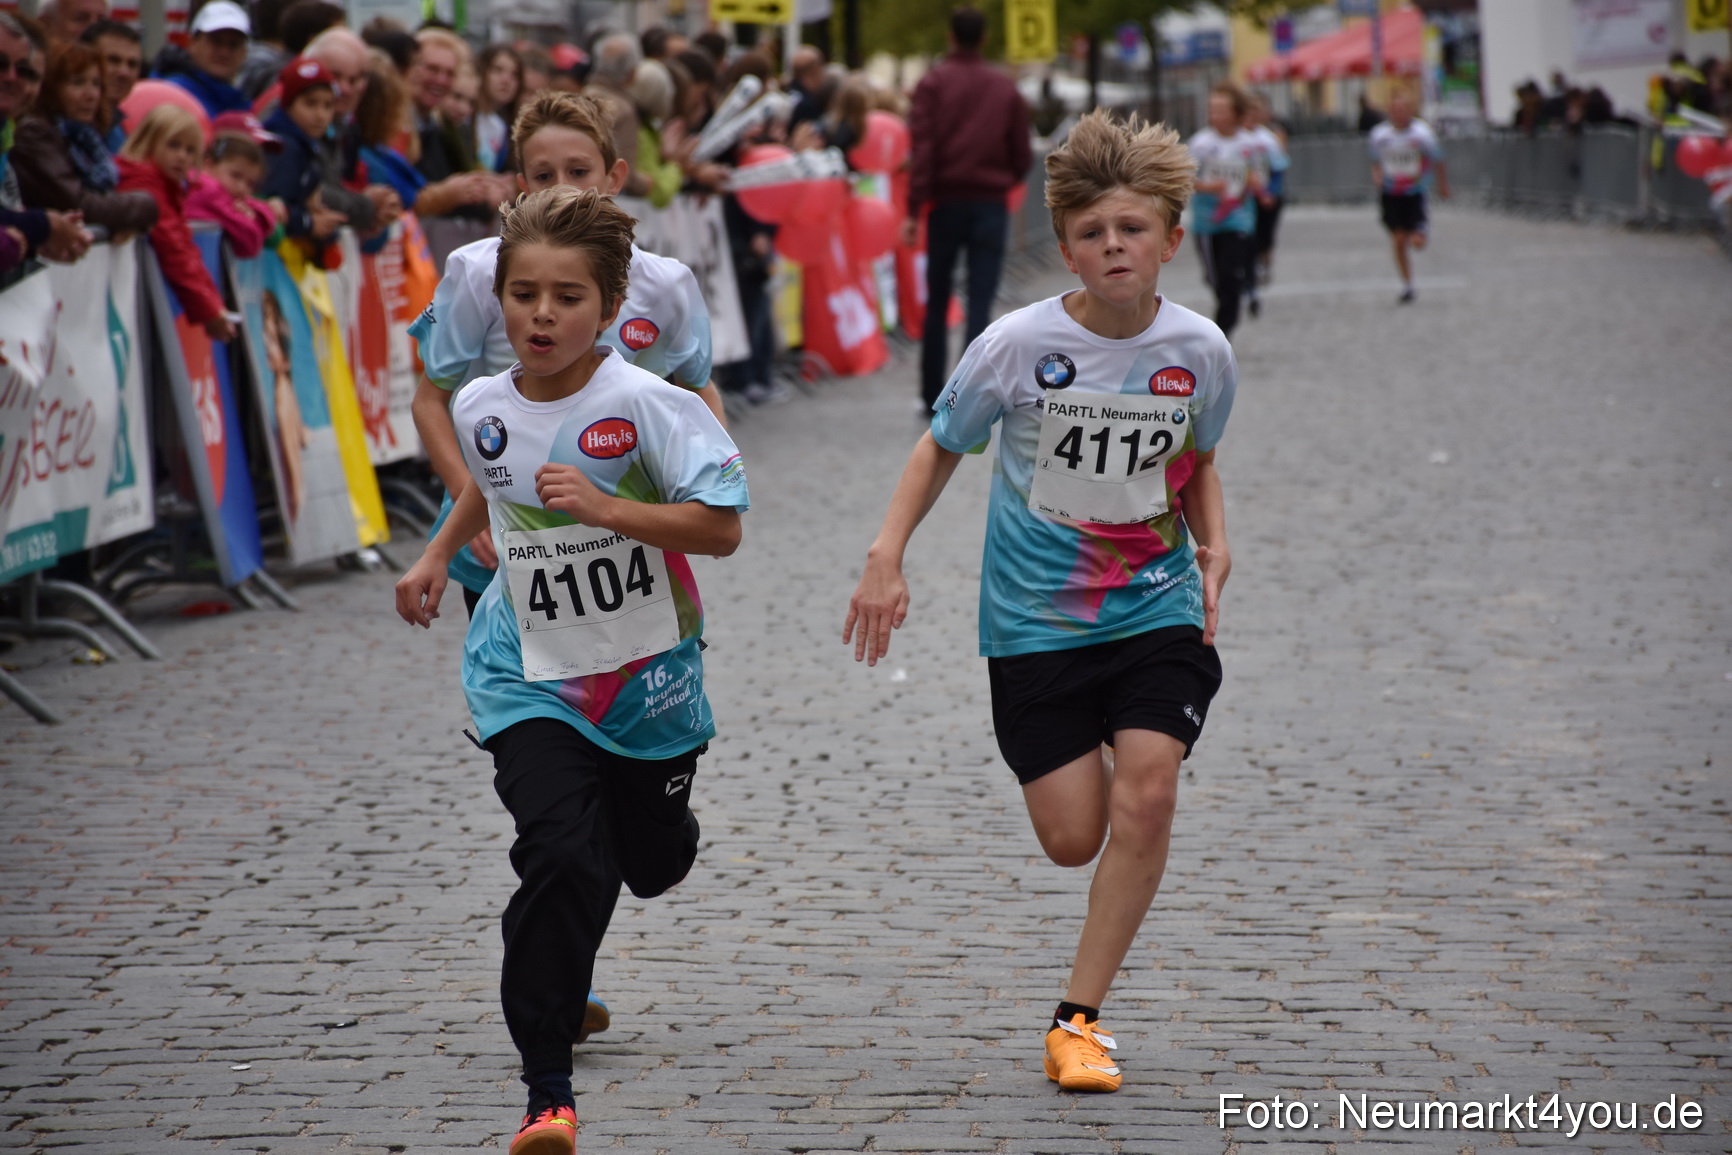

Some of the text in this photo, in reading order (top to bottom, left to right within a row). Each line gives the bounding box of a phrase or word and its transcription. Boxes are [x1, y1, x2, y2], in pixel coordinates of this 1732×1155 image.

[626, 325, 655, 344] Hervis
[1157, 376, 1190, 393] Hervis
[1048, 402, 1097, 419] PARTL
[1101, 407, 1167, 423] Neumarkt
[587, 429, 634, 449] Hervis
[1054, 426, 1173, 477] 4112
[483, 466, 512, 480] PARTL
[508, 545, 553, 561] PARTL
[529, 545, 655, 621] 4104
[641, 664, 673, 691] 16.
